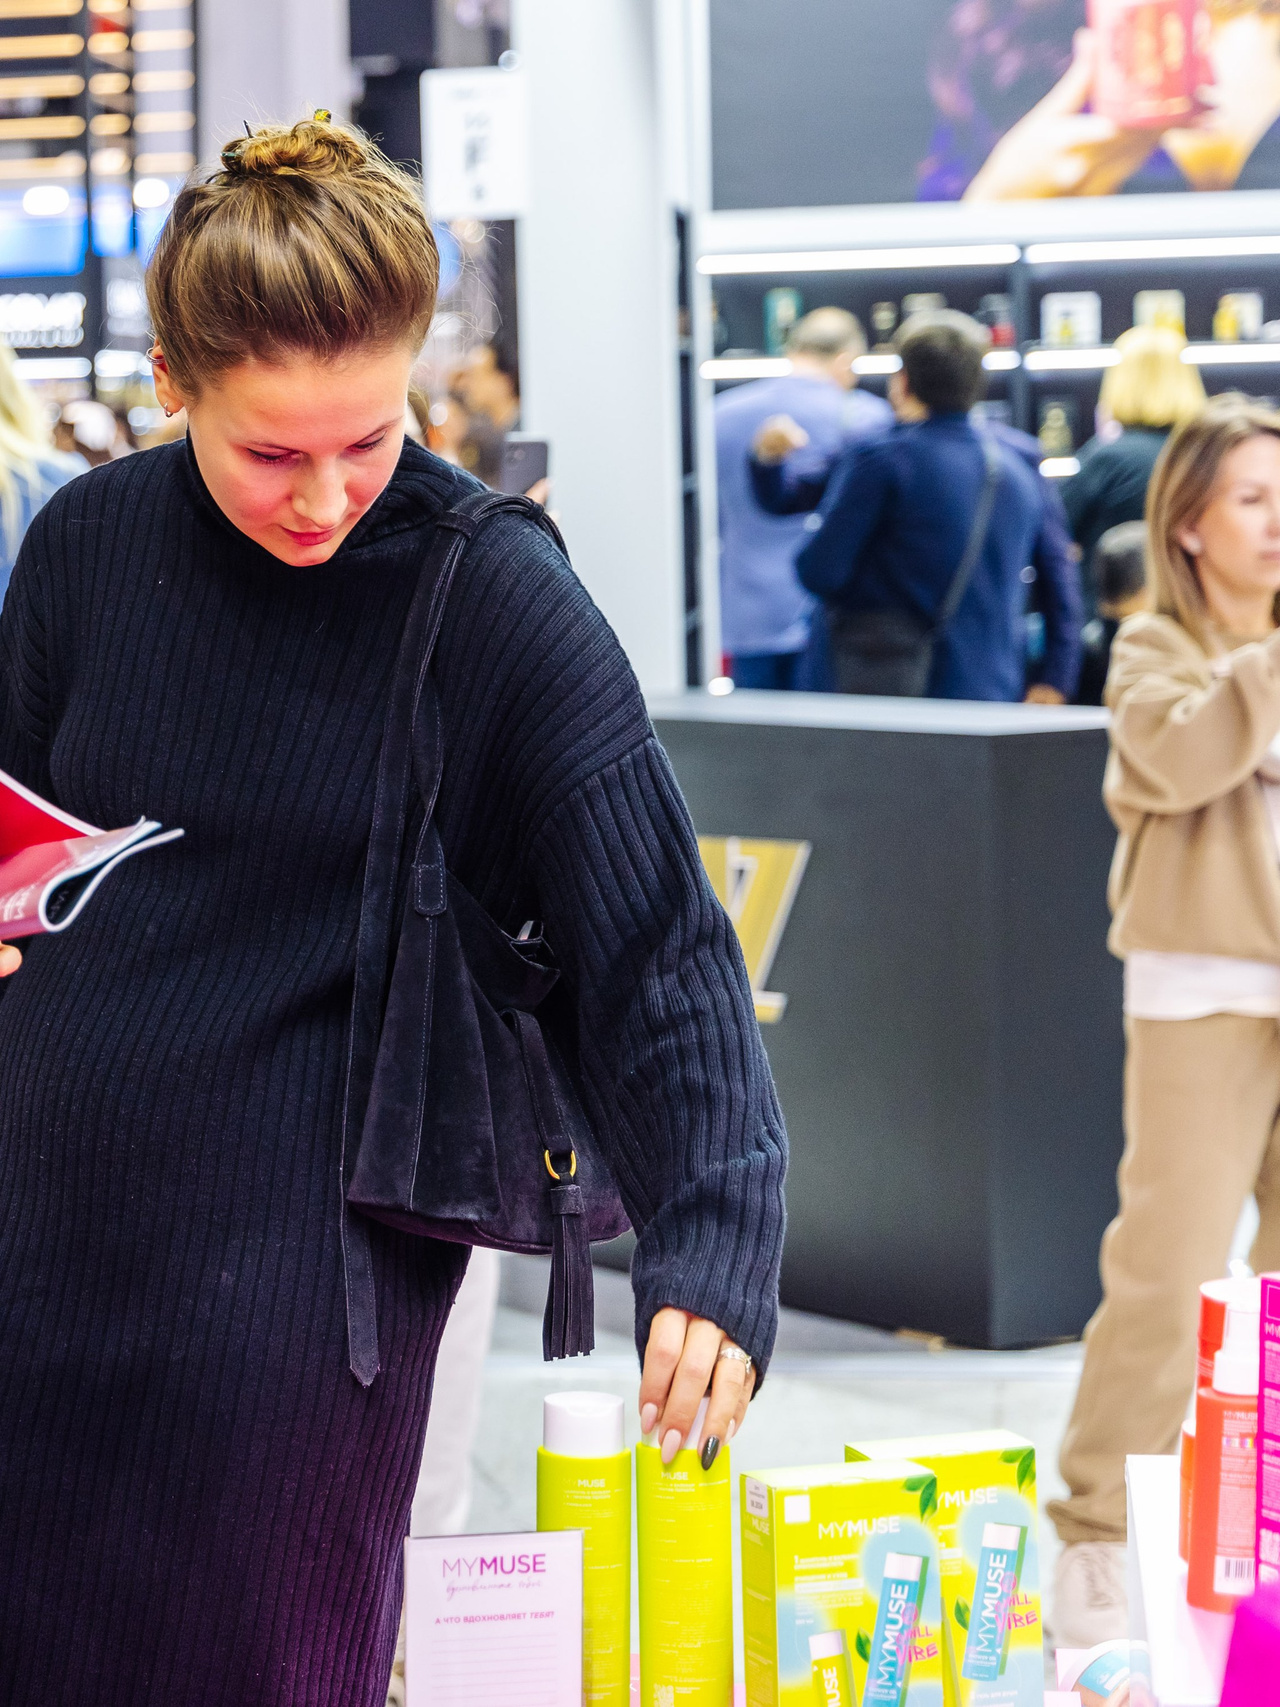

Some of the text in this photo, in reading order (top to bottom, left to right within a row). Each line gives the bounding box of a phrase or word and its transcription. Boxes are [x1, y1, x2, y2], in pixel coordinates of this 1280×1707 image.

[818, 1516, 901, 1540] MYMUSE
[442, 1553, 547, 1578] MYMUSE
[435, 1610, 555, 1625] А ЧТО ВДОХНОВЛЯЕТ ТЕБЯ?
[976, 1552, 1008, 1653] MYMUSE
[877, 1583, 909, 1686] MYMUSE
[822, 1666, 841, 1707] USE
